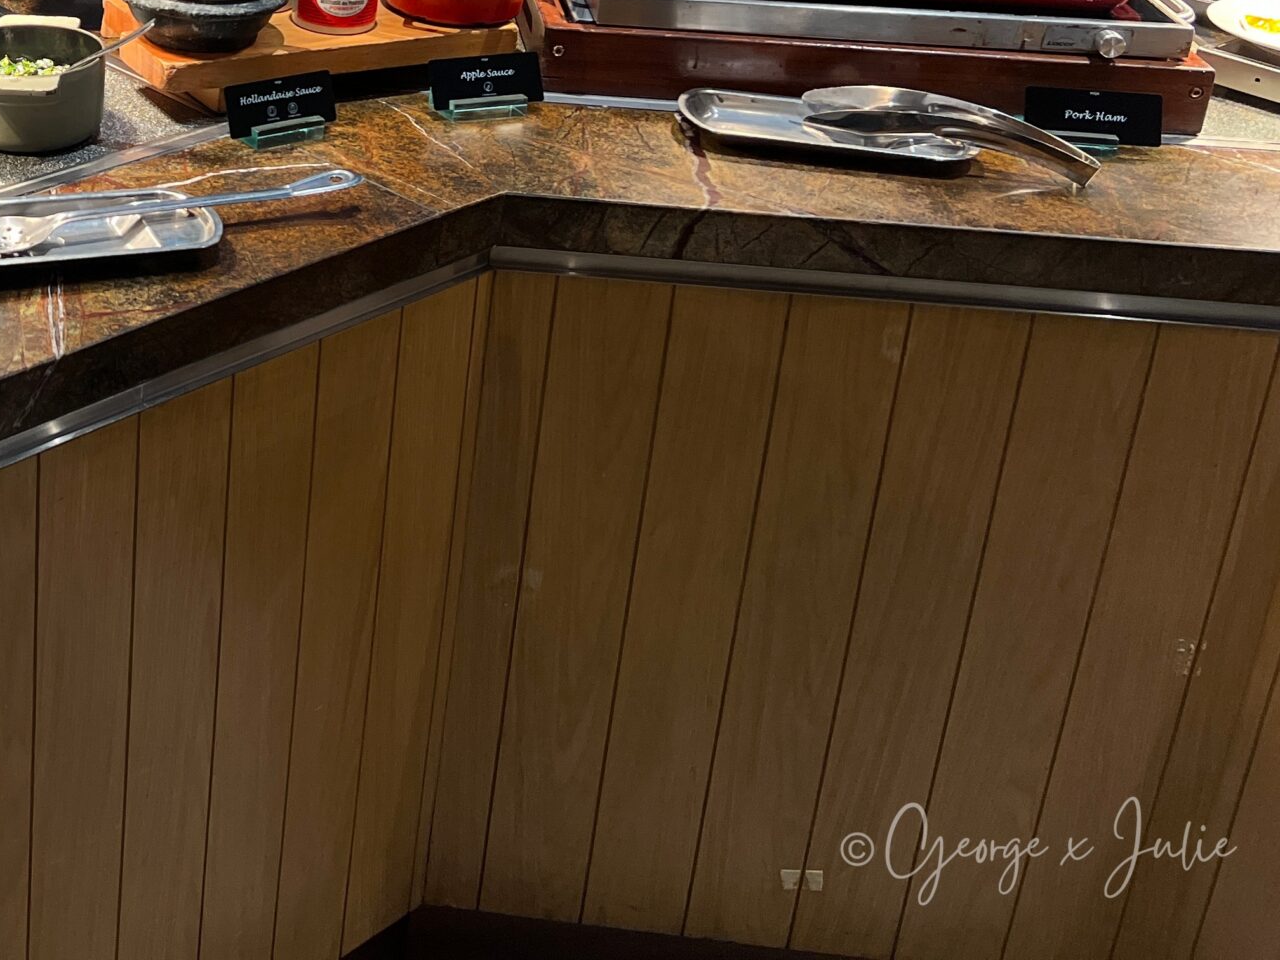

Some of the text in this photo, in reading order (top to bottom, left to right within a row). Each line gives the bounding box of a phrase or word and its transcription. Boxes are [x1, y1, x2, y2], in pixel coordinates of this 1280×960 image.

[460, 68, 516, 81] Apple Sauce
[239, 85, 323, 106] Hollandaise Sauce
[1064, 109, 1128, 123] Pork Ham
